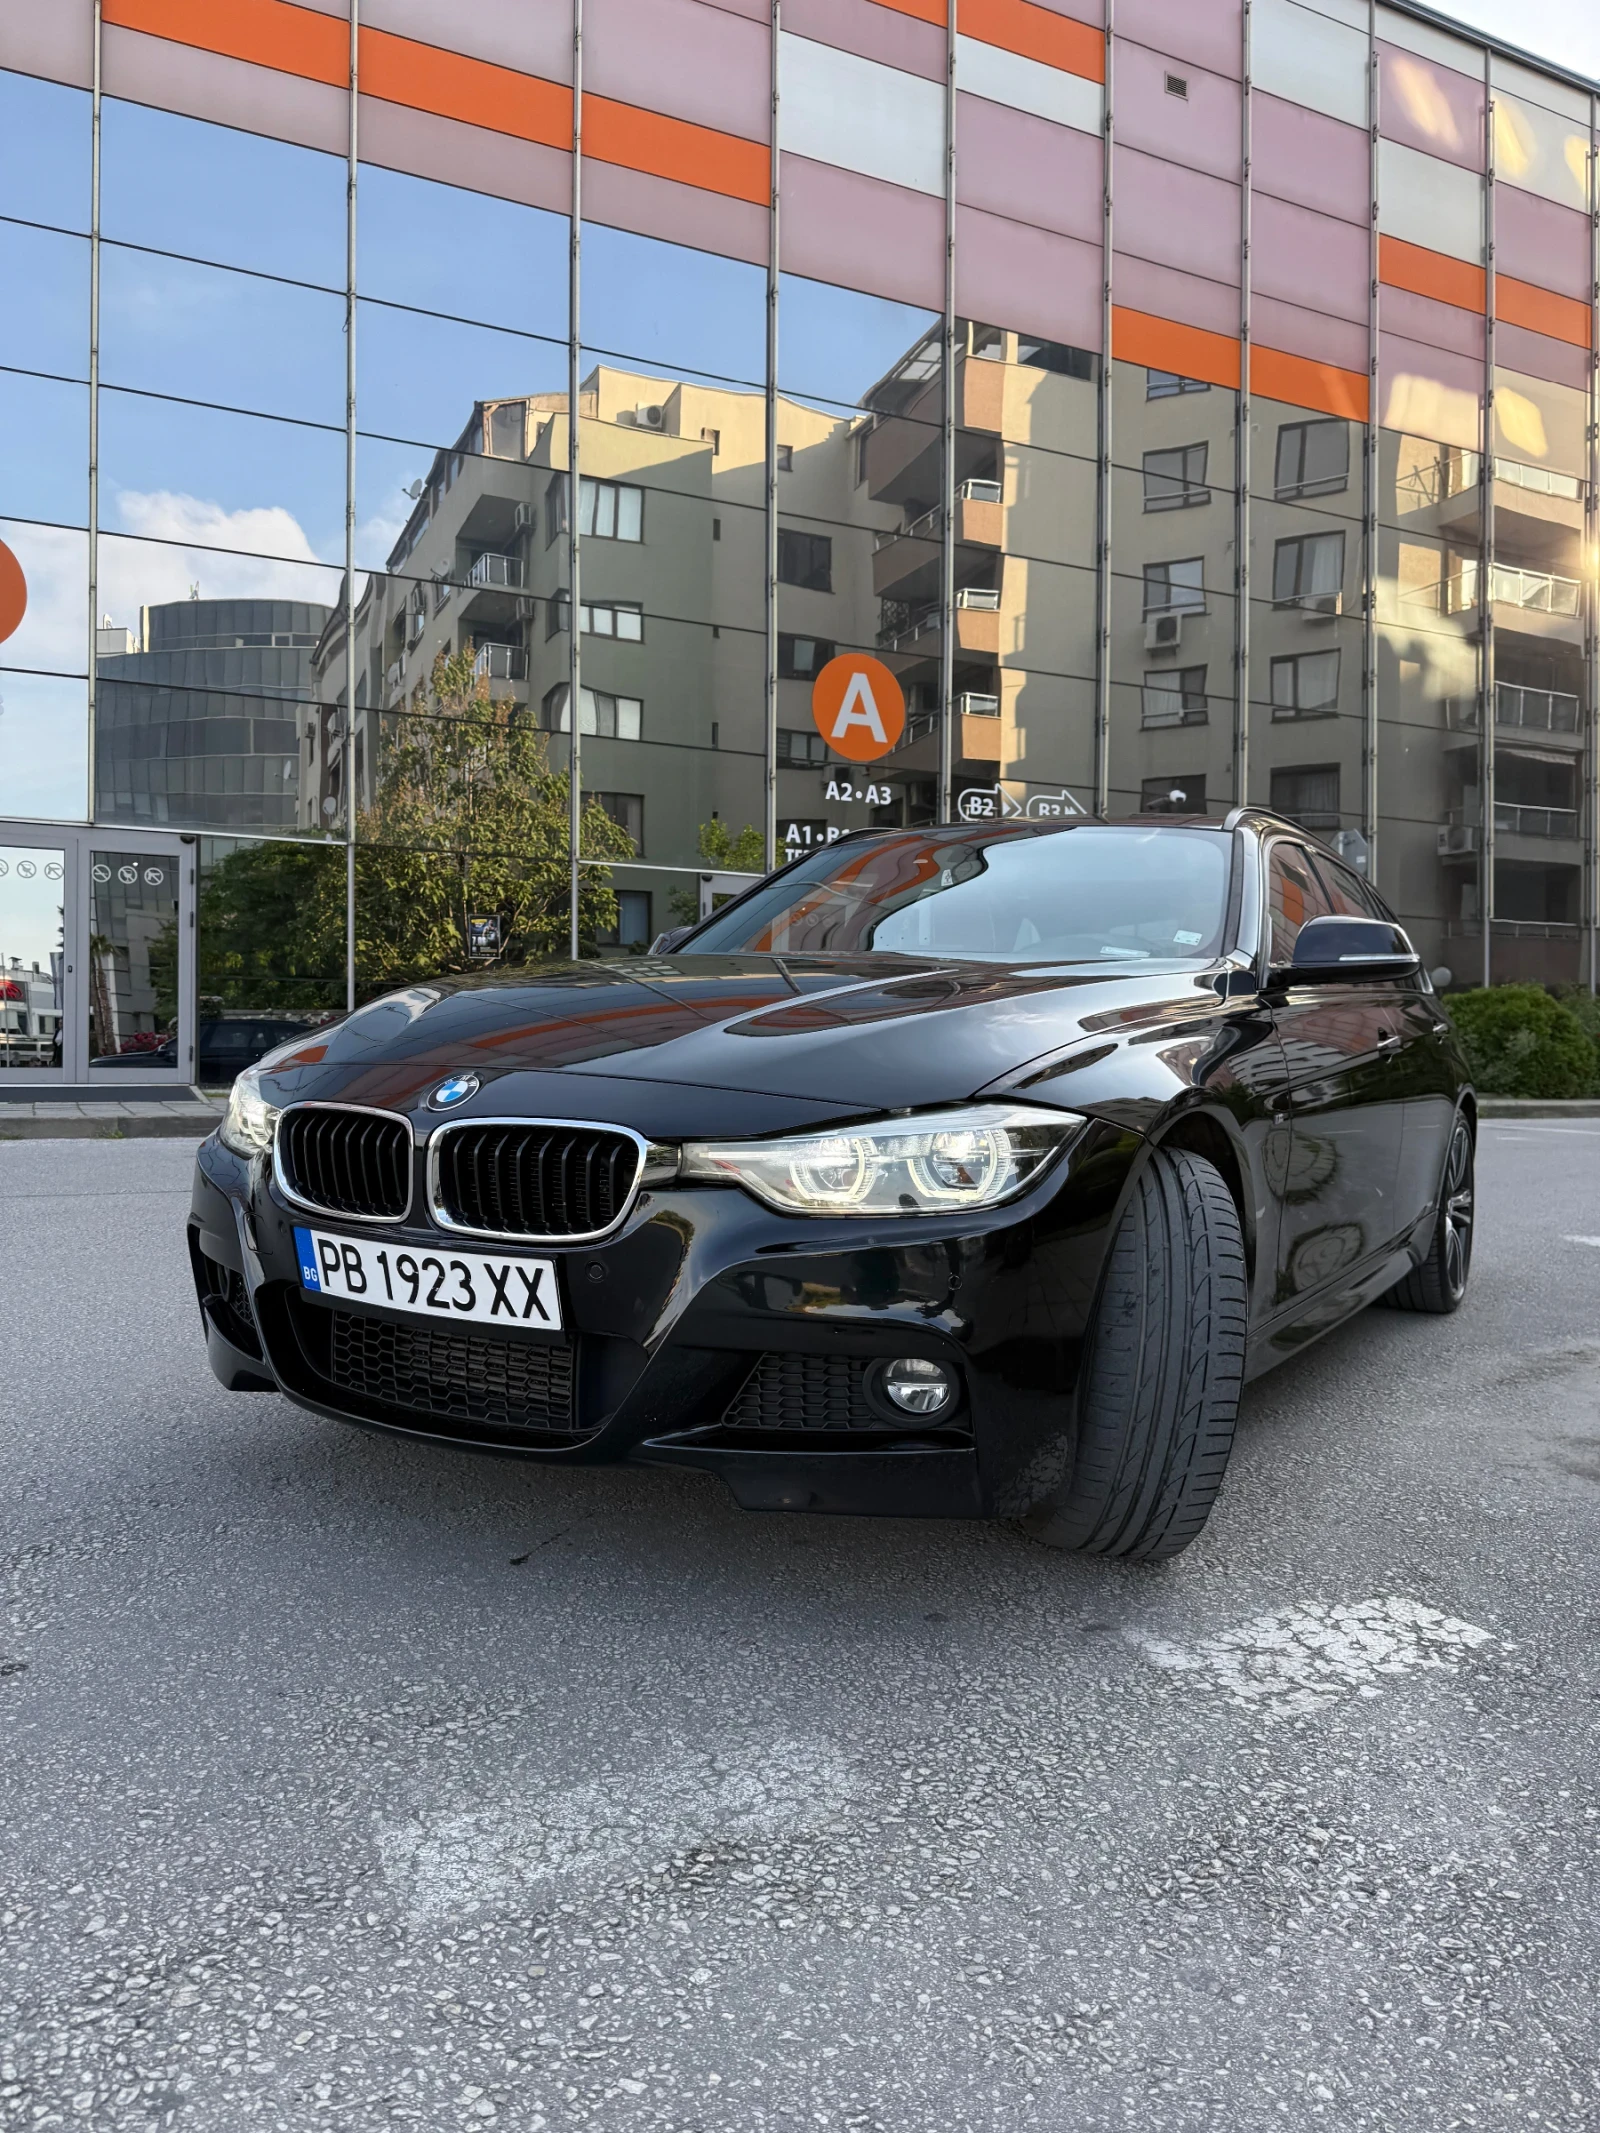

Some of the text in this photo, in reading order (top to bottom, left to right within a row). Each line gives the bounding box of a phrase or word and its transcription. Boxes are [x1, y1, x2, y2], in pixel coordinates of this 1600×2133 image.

[831, 672, 888, 743] A
[970, 796, 994, 816] B2
[303, 1266, 318, 1282] BG
[317, 1238, 551, 1321] PB 1923 XX
